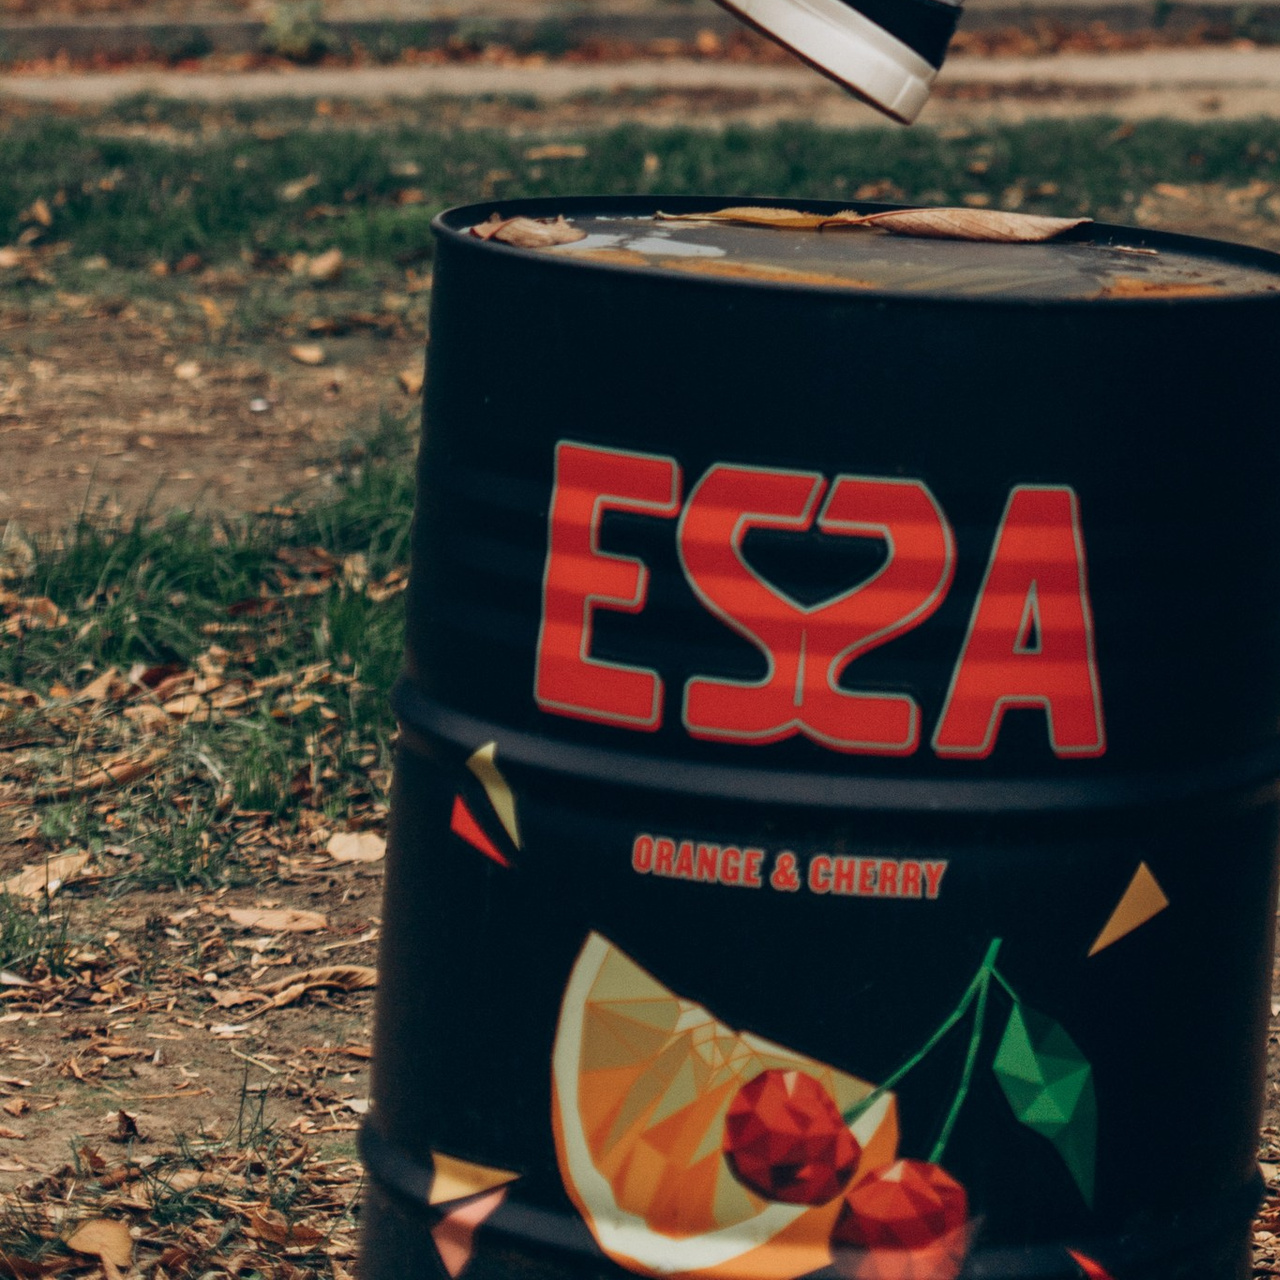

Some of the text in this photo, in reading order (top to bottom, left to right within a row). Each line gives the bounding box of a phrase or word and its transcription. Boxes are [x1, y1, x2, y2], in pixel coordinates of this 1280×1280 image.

[632, 834, 948, 900] ORANGE & CHERRY
